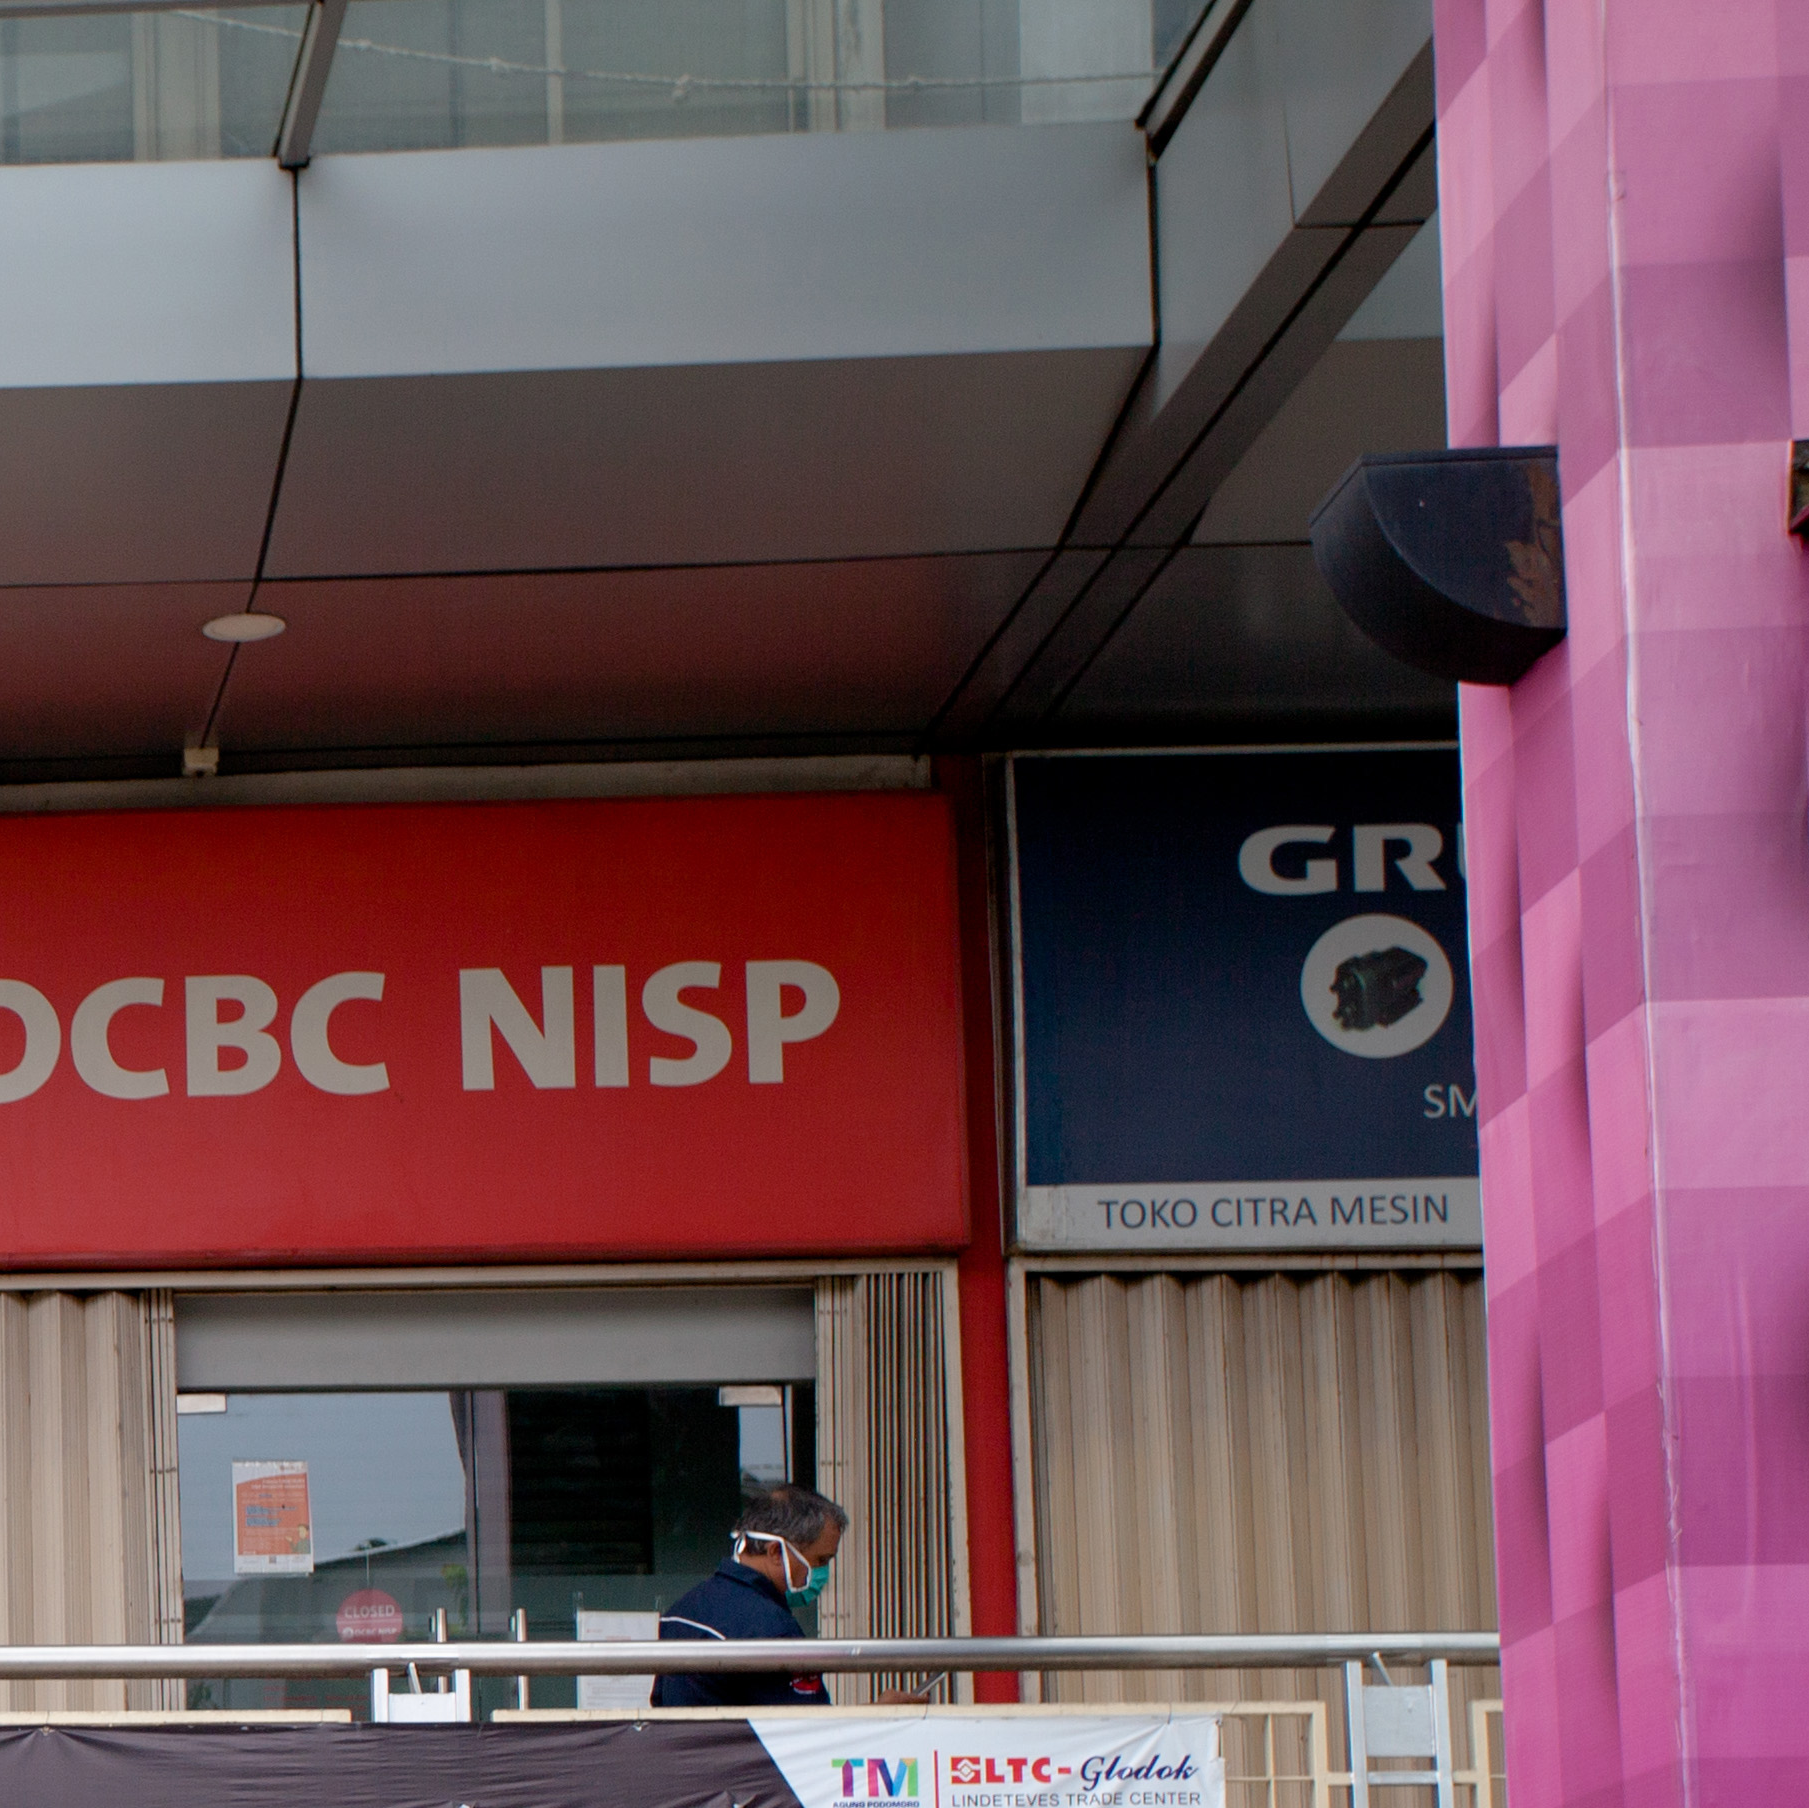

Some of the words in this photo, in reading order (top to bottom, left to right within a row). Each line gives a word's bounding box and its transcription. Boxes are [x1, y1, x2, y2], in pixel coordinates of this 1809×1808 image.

[1238, 823, 1465, 895] GR
[459, 959, 841, 1091] NISP
[1097, 1200, 1197, 1230] TOKO
[1210, 1198, 1317, 1228] CITRA
[1330, 1195, 1449, 1225] MESIN
[344, 1605, 395, 1619] CLOSED
[831, 1757, 919, 1798] TM
[832, 1800, 865, 1808] AGUNG
[866, 1800, 920, 1808] PODOMORO
[951, 1793, 1060, 1808] LINDETEVES
[1067, 1792, 1123, 1807] TRADE
[1128, 1790, 1202, 1806] CENTER
